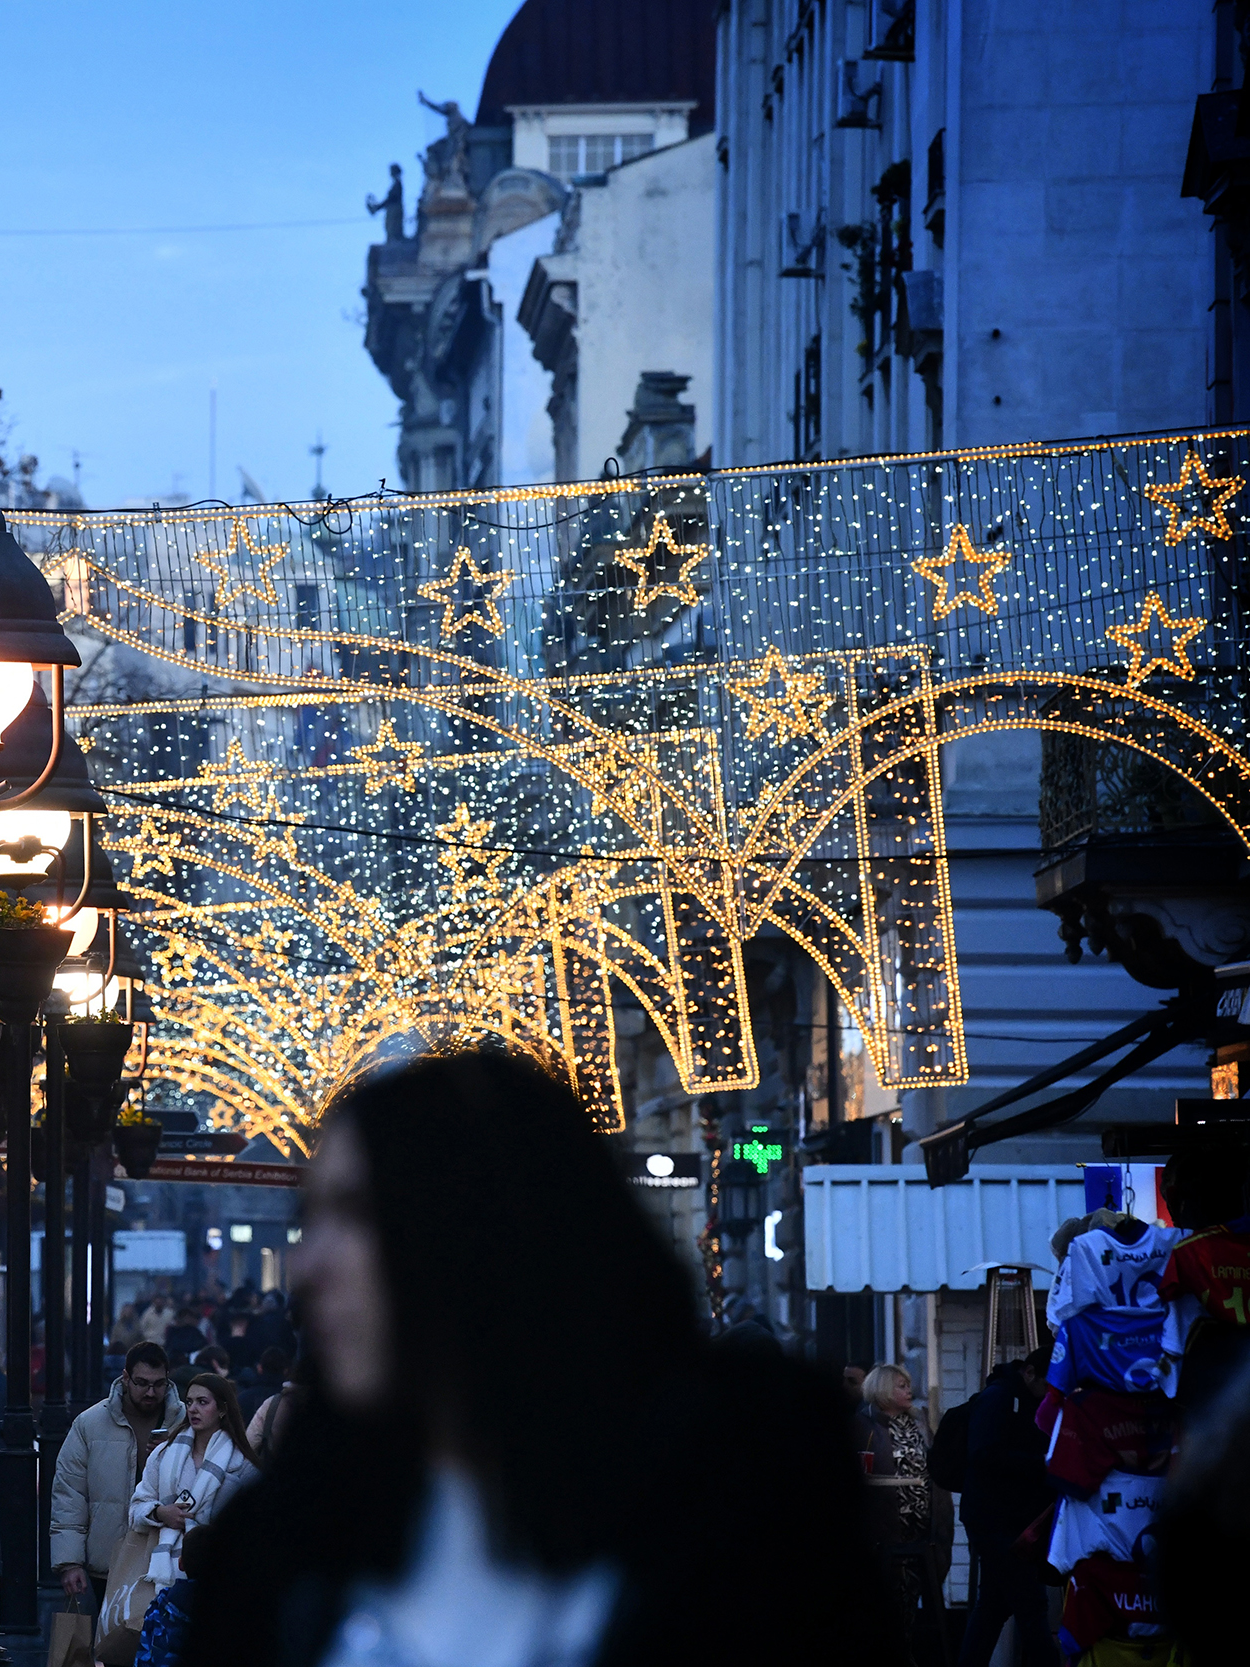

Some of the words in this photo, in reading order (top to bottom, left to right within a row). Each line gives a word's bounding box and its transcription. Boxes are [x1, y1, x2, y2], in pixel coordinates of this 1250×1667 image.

[149, 1166, 181, 1176] ational
[184, 1167, 208, 1177] Bank
[210, 1168, 221, 1178] of
[222, 1168, 252, 1179] Serbia
[254, 1170, 297, 1181] Exhibition
[1103, 1418, 1147, 1440] AMINE
